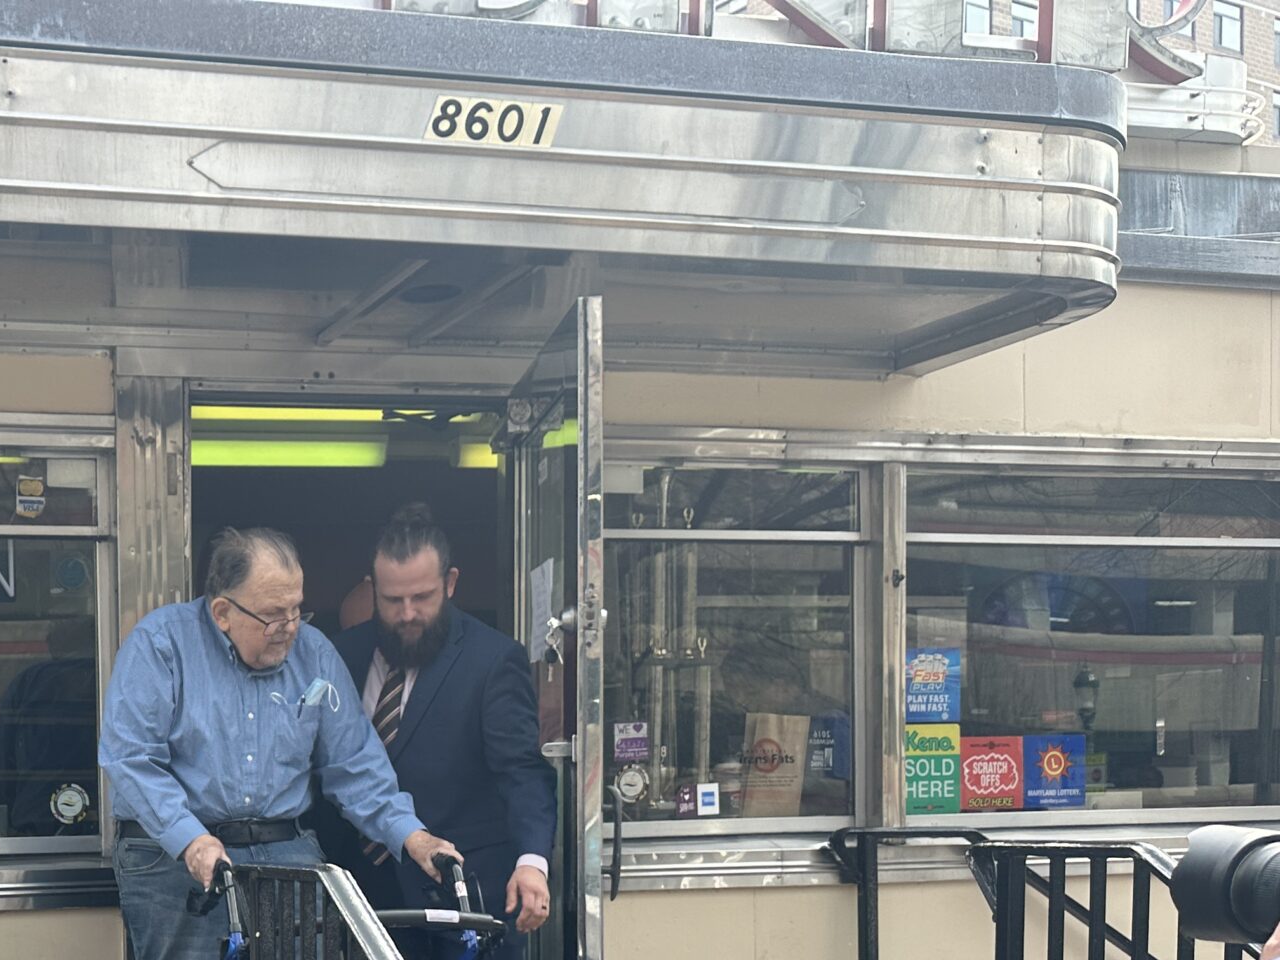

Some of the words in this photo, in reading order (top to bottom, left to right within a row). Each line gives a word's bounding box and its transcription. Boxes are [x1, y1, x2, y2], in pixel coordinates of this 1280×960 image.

[432, 98, 551, 144] 8601
[912, 669, 947, 682] Fast
[912, 683, 943, 691] PLAY
[907, 694, 928, 703] PLAY
[929, 694, 951, 703] FAST.
[909, 703, 927, 712] WIN
[928, 702, 950, 712] FAST.
[617, 725, 631, 735] WE
[771, 753, 796, 764] Fats
[905, 758, 955, 777] SOLD
[972, 761, 1008, 774] SCRATCH
[980, 774, 1001, 787] OFFS
[905, 780, 955, 798] HERE
[1027, 789, 1056, 797] MARYLAND
[968, 798, 990, 807] SOLD
[991, 797, 1014, 806] HERE
